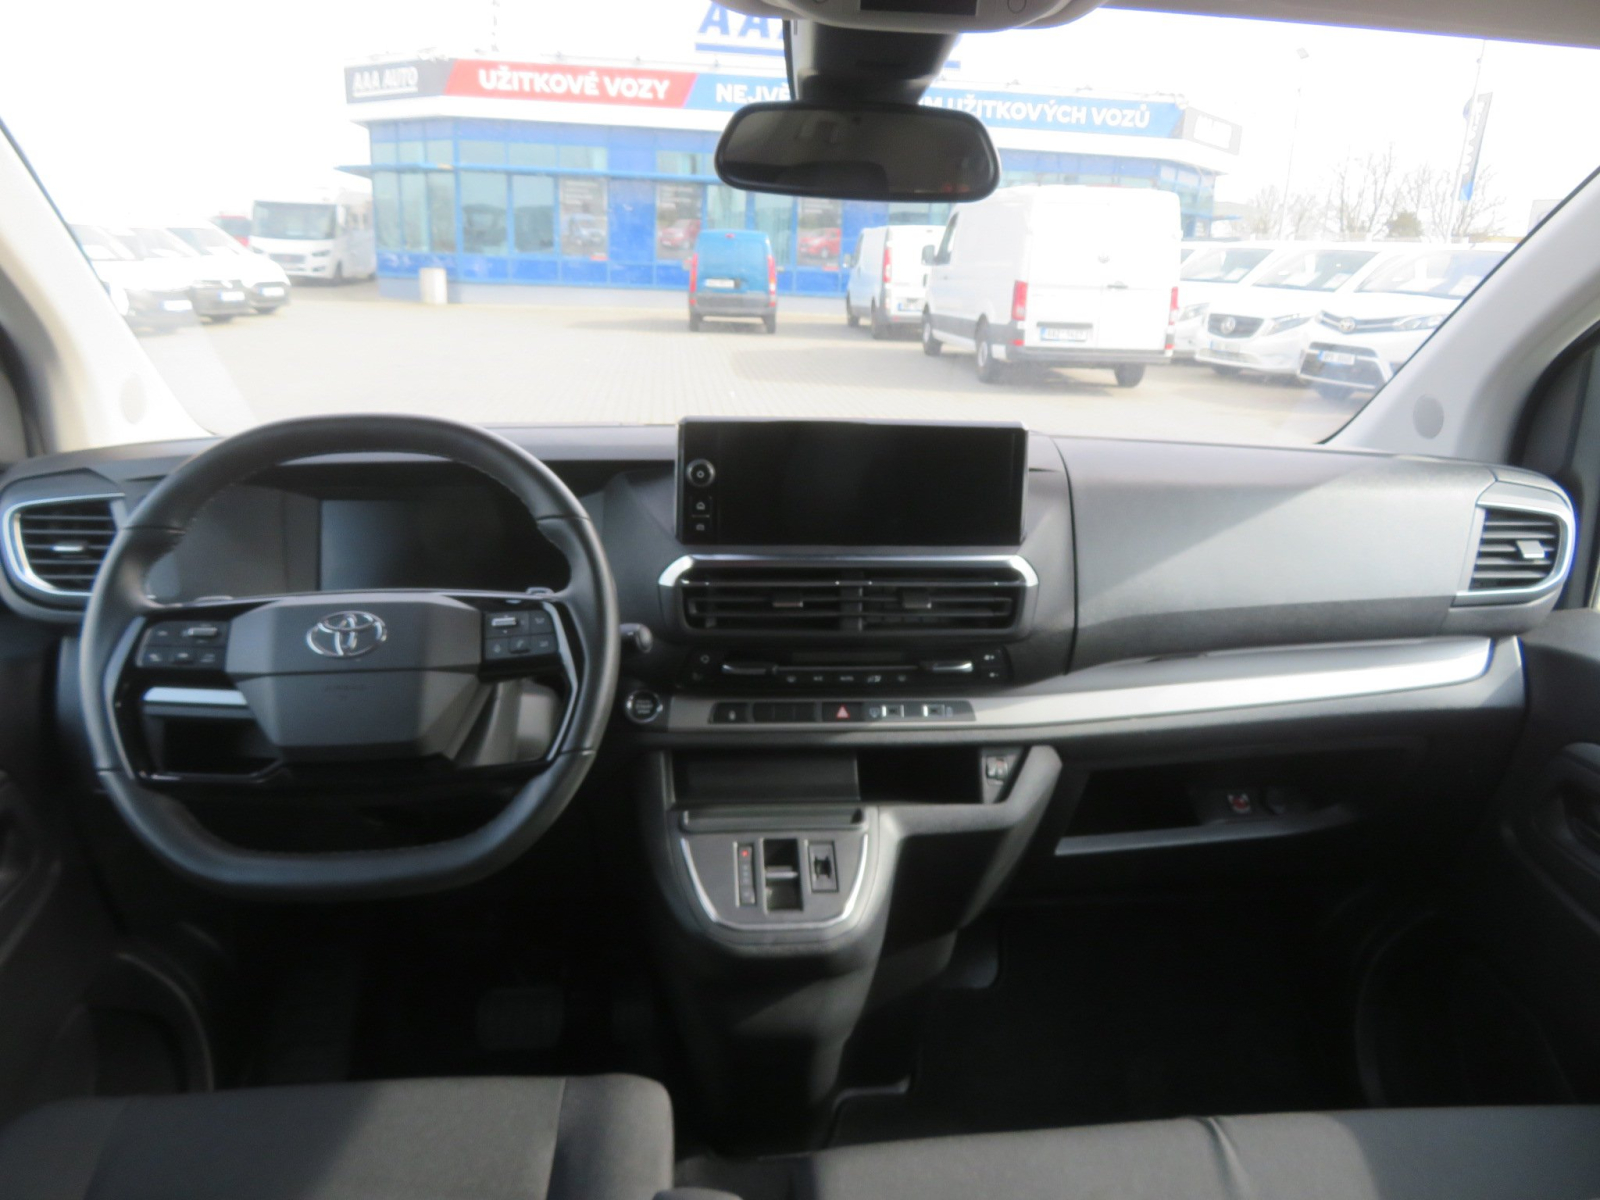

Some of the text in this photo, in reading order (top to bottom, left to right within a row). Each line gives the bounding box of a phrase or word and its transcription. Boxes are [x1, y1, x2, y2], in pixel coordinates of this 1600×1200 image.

[698, 0, 784, 40] AA
[352, 66, 419, 91] AAA AUTO
[479, 66, 670, 99] UŽITKOVÉ VOZY
[1091, 104, 1150, 128] VOZŮ
